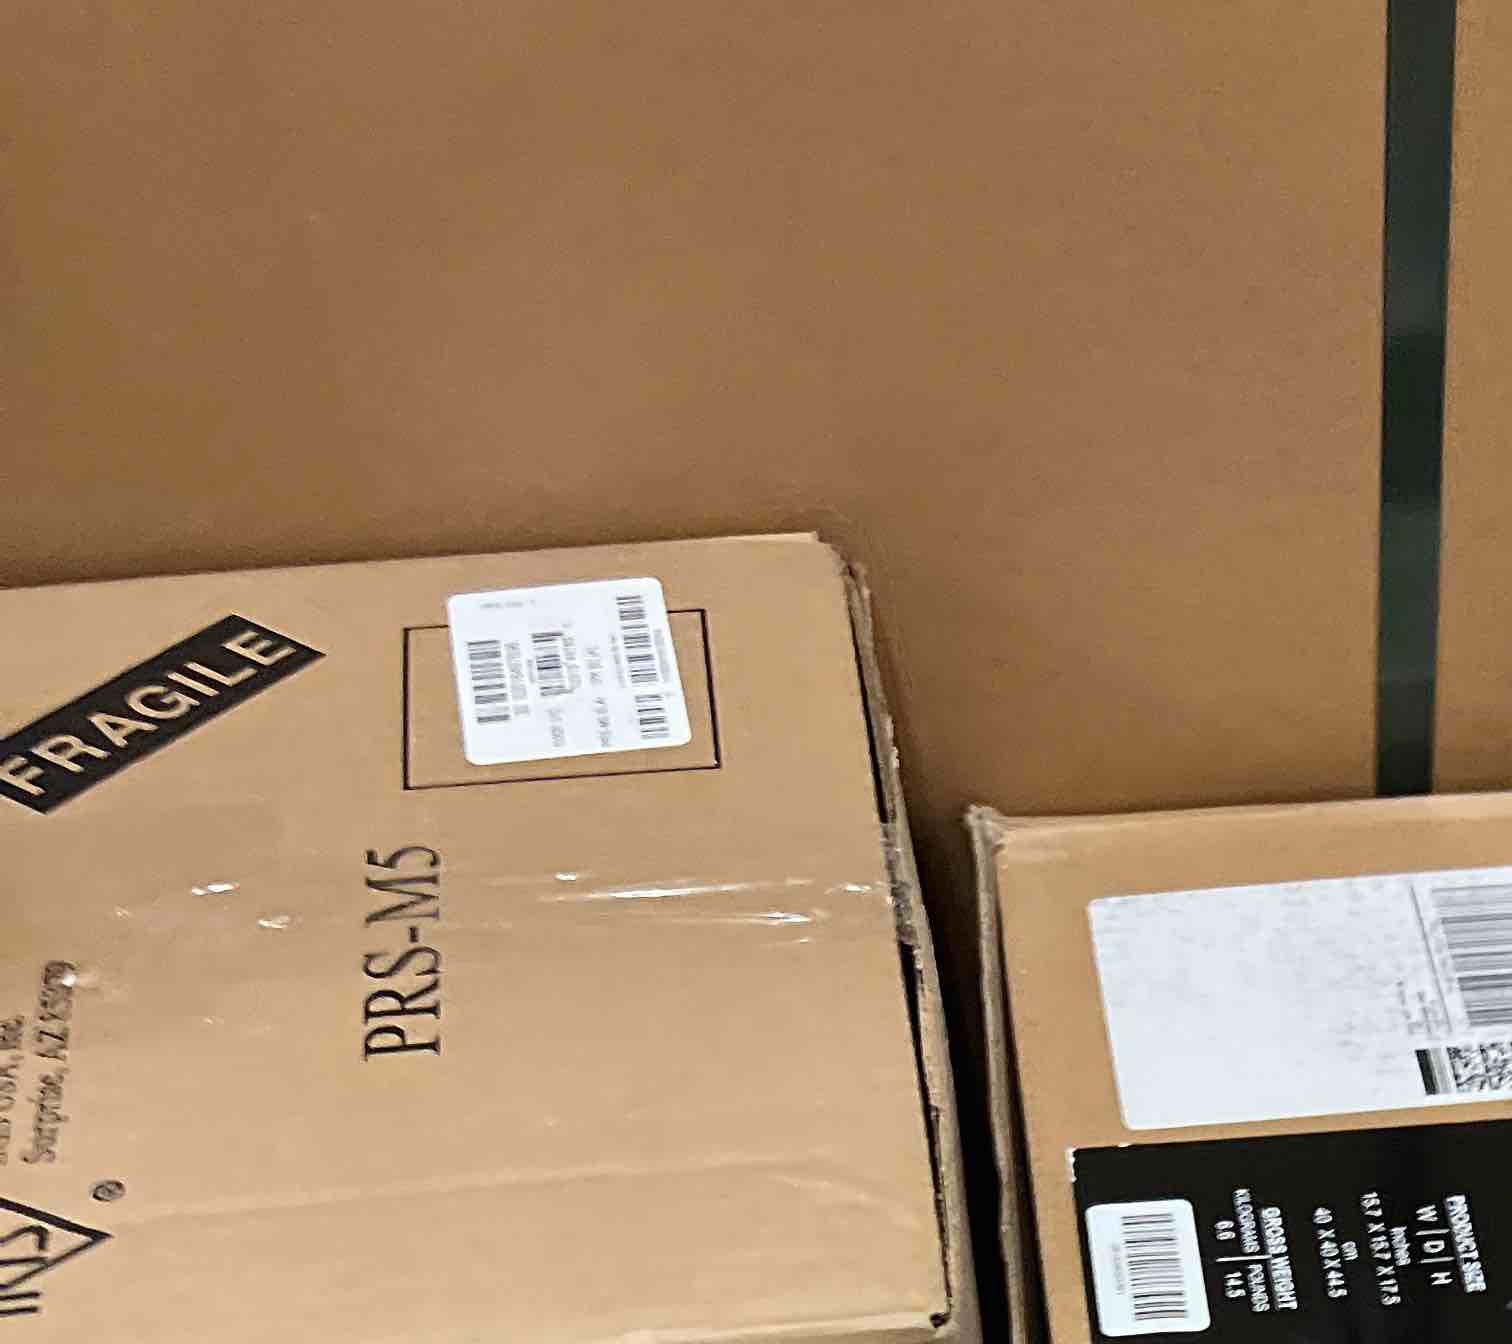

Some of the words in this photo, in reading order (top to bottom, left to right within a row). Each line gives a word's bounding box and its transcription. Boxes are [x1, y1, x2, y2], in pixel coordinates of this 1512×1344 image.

[0, 629, 298, 797] FRAGILE
[363, 845, 442, 1062] PRS-M5
[1260, 1205, 1289, 1255] GROSS
[1415, 1203, 1439, 1223] W
[1445, 1194, 1480, 1261] PRODUCT
[1422, 1238, 1446, 1255] D
[1246, 1263, 1272, 1313] POUNDS
[1270, 1254, 1299, 1311] WEIGHT
[1429, 1270, 1454, 1287] H
[1459, 1260, 1488, 1294] SIZE
